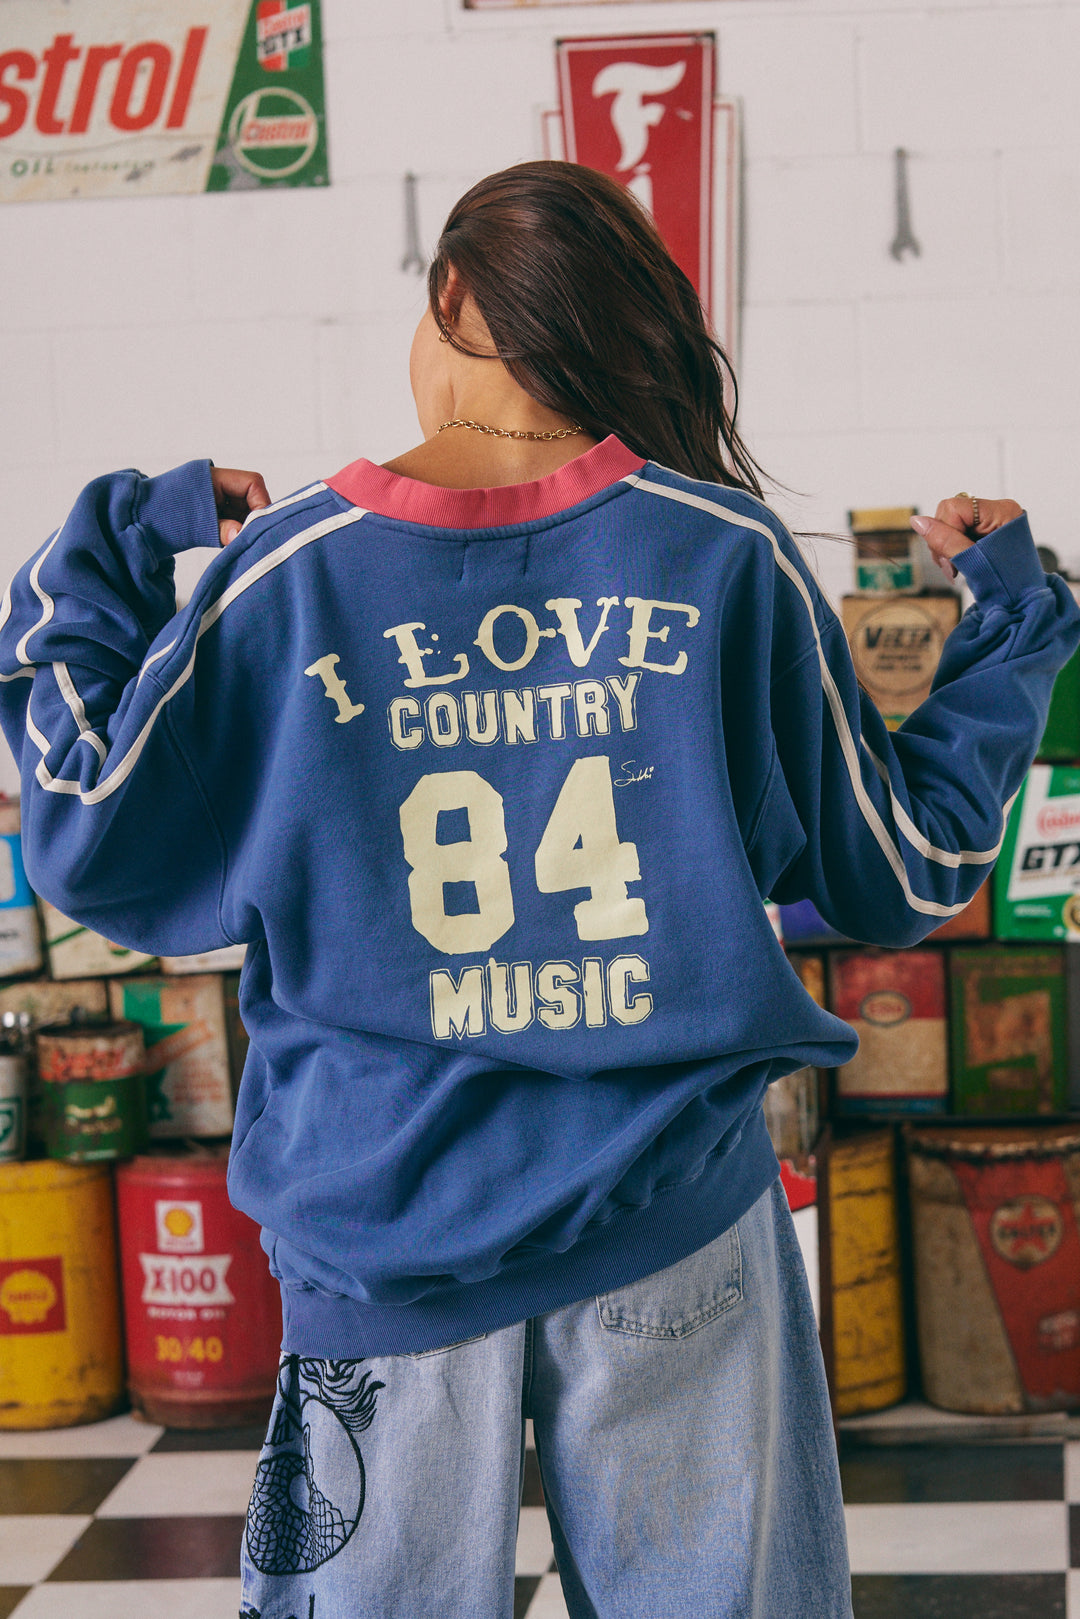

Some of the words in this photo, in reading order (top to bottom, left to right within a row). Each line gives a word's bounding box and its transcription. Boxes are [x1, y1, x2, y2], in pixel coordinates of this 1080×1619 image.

[304, 653, 365, 723] I
[383, 596, 701, 688] LOVE
[386, 672, 643, 751] COUNTRY
[399, 755, 650, 955] 84
[429, 955, 653, 1040] MUSIC
